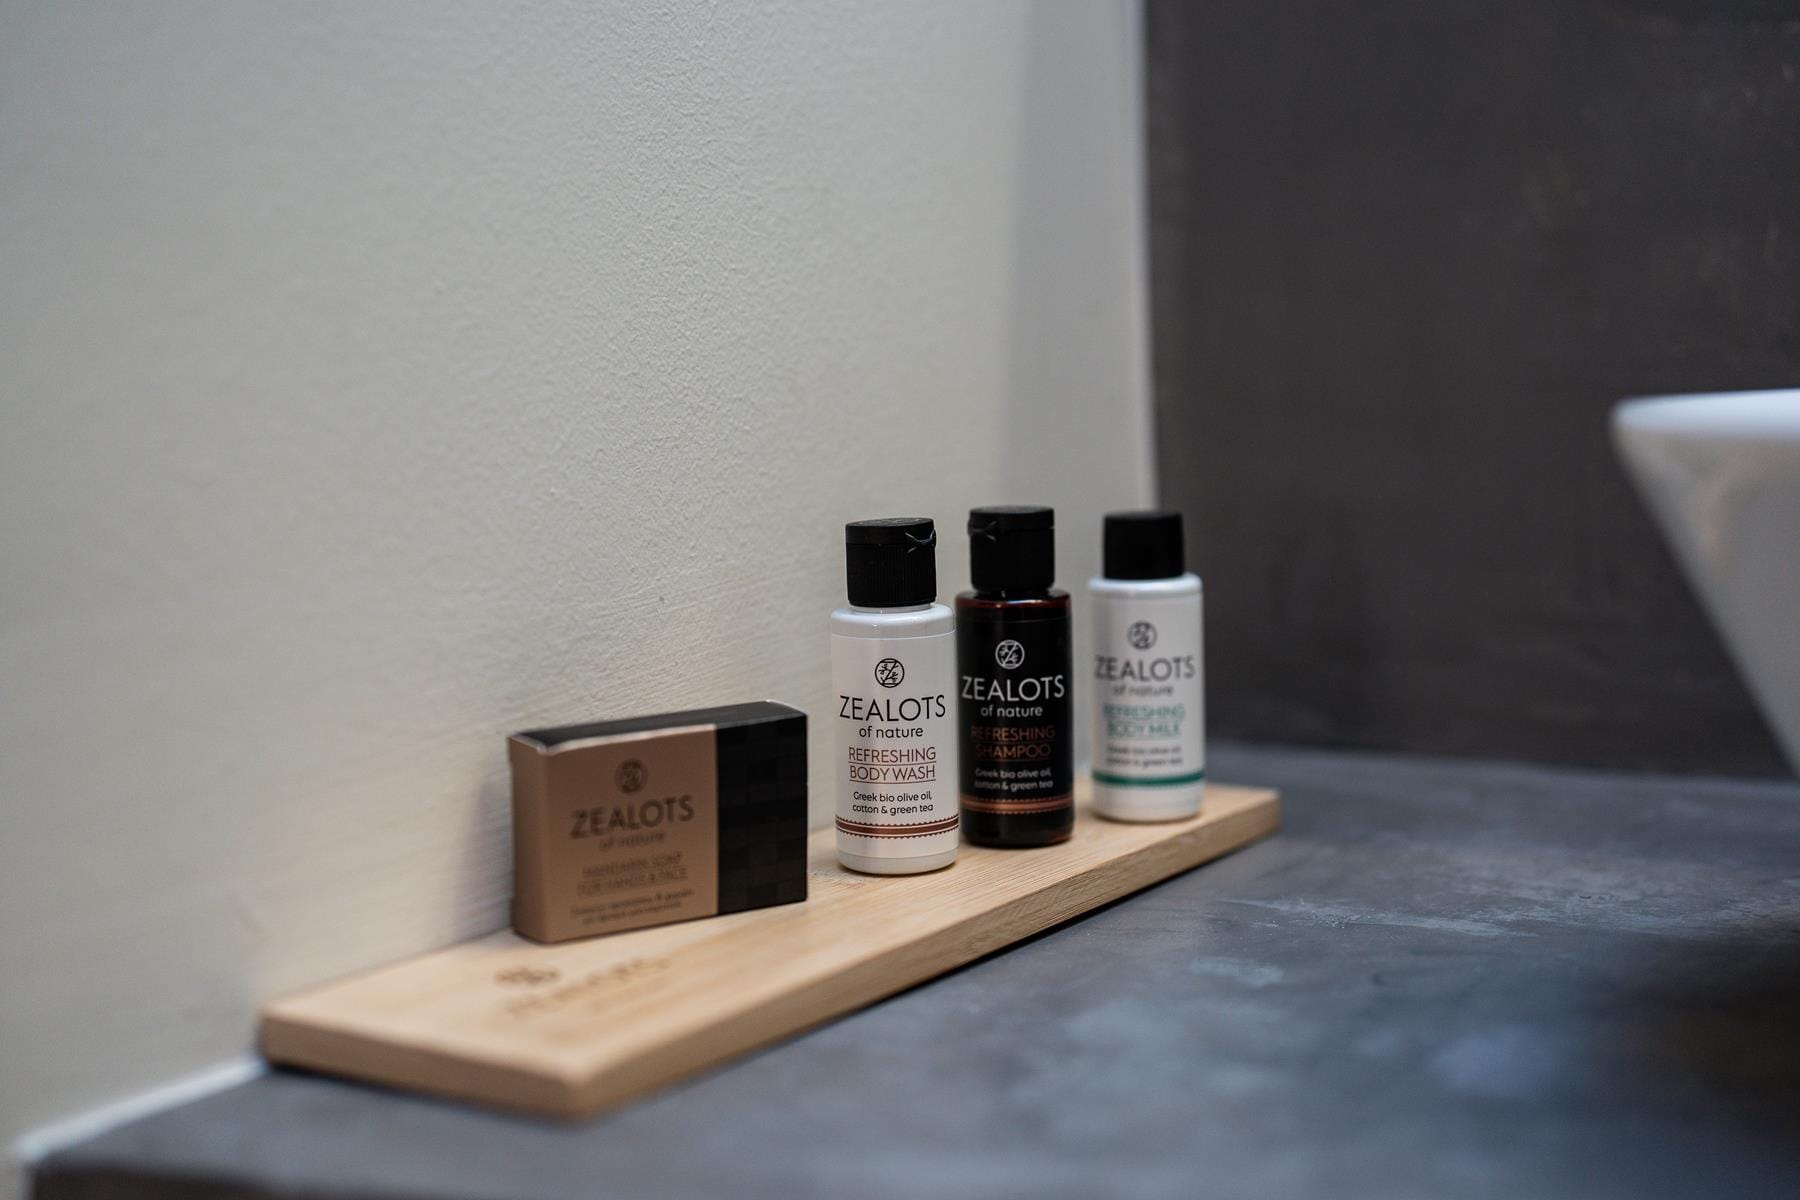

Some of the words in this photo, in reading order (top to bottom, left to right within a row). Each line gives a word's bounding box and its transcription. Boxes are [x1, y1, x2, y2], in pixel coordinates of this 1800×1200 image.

[1095, 655, 1196, 682] ZEALOTS
[961, 674, 1065, 702] ZEALOTS
[839, 694, 946, 722] ZEALOTS
[980, 704, 994, 717] of
[997, 706, 1043, 718] nature
[859, 725, 873, 739] of
[876, 727, 924, 739] nature
[970, 725, 1056, 742] REFRESHING
[848, 746, 937, 763] REFRESHING
[975, 743, 1052, 759] SHAMPOO
[849, 764, 890, 781] BODY
[892, 764, 936, 781] WASH
[1000, 768, 1016, 779] bio
[1017, 768, 1039, 779] olive
[1001, 780, 1009, 791] &
[1010, 781, 1038, 792] green
[1039, 779, 1054, 789] tea
[852, 791, 878, 802] Greek
[879, 792, 895, 803] bio
[897, 791, 919, 802] olive
[570, 795, 696, 839] ZEALOTS
[852, 803, 879, 814] cotton
[881, 804, 888, 814] &
[890, 806, 918, 817] green
[919, 803, 934, 813] tea
